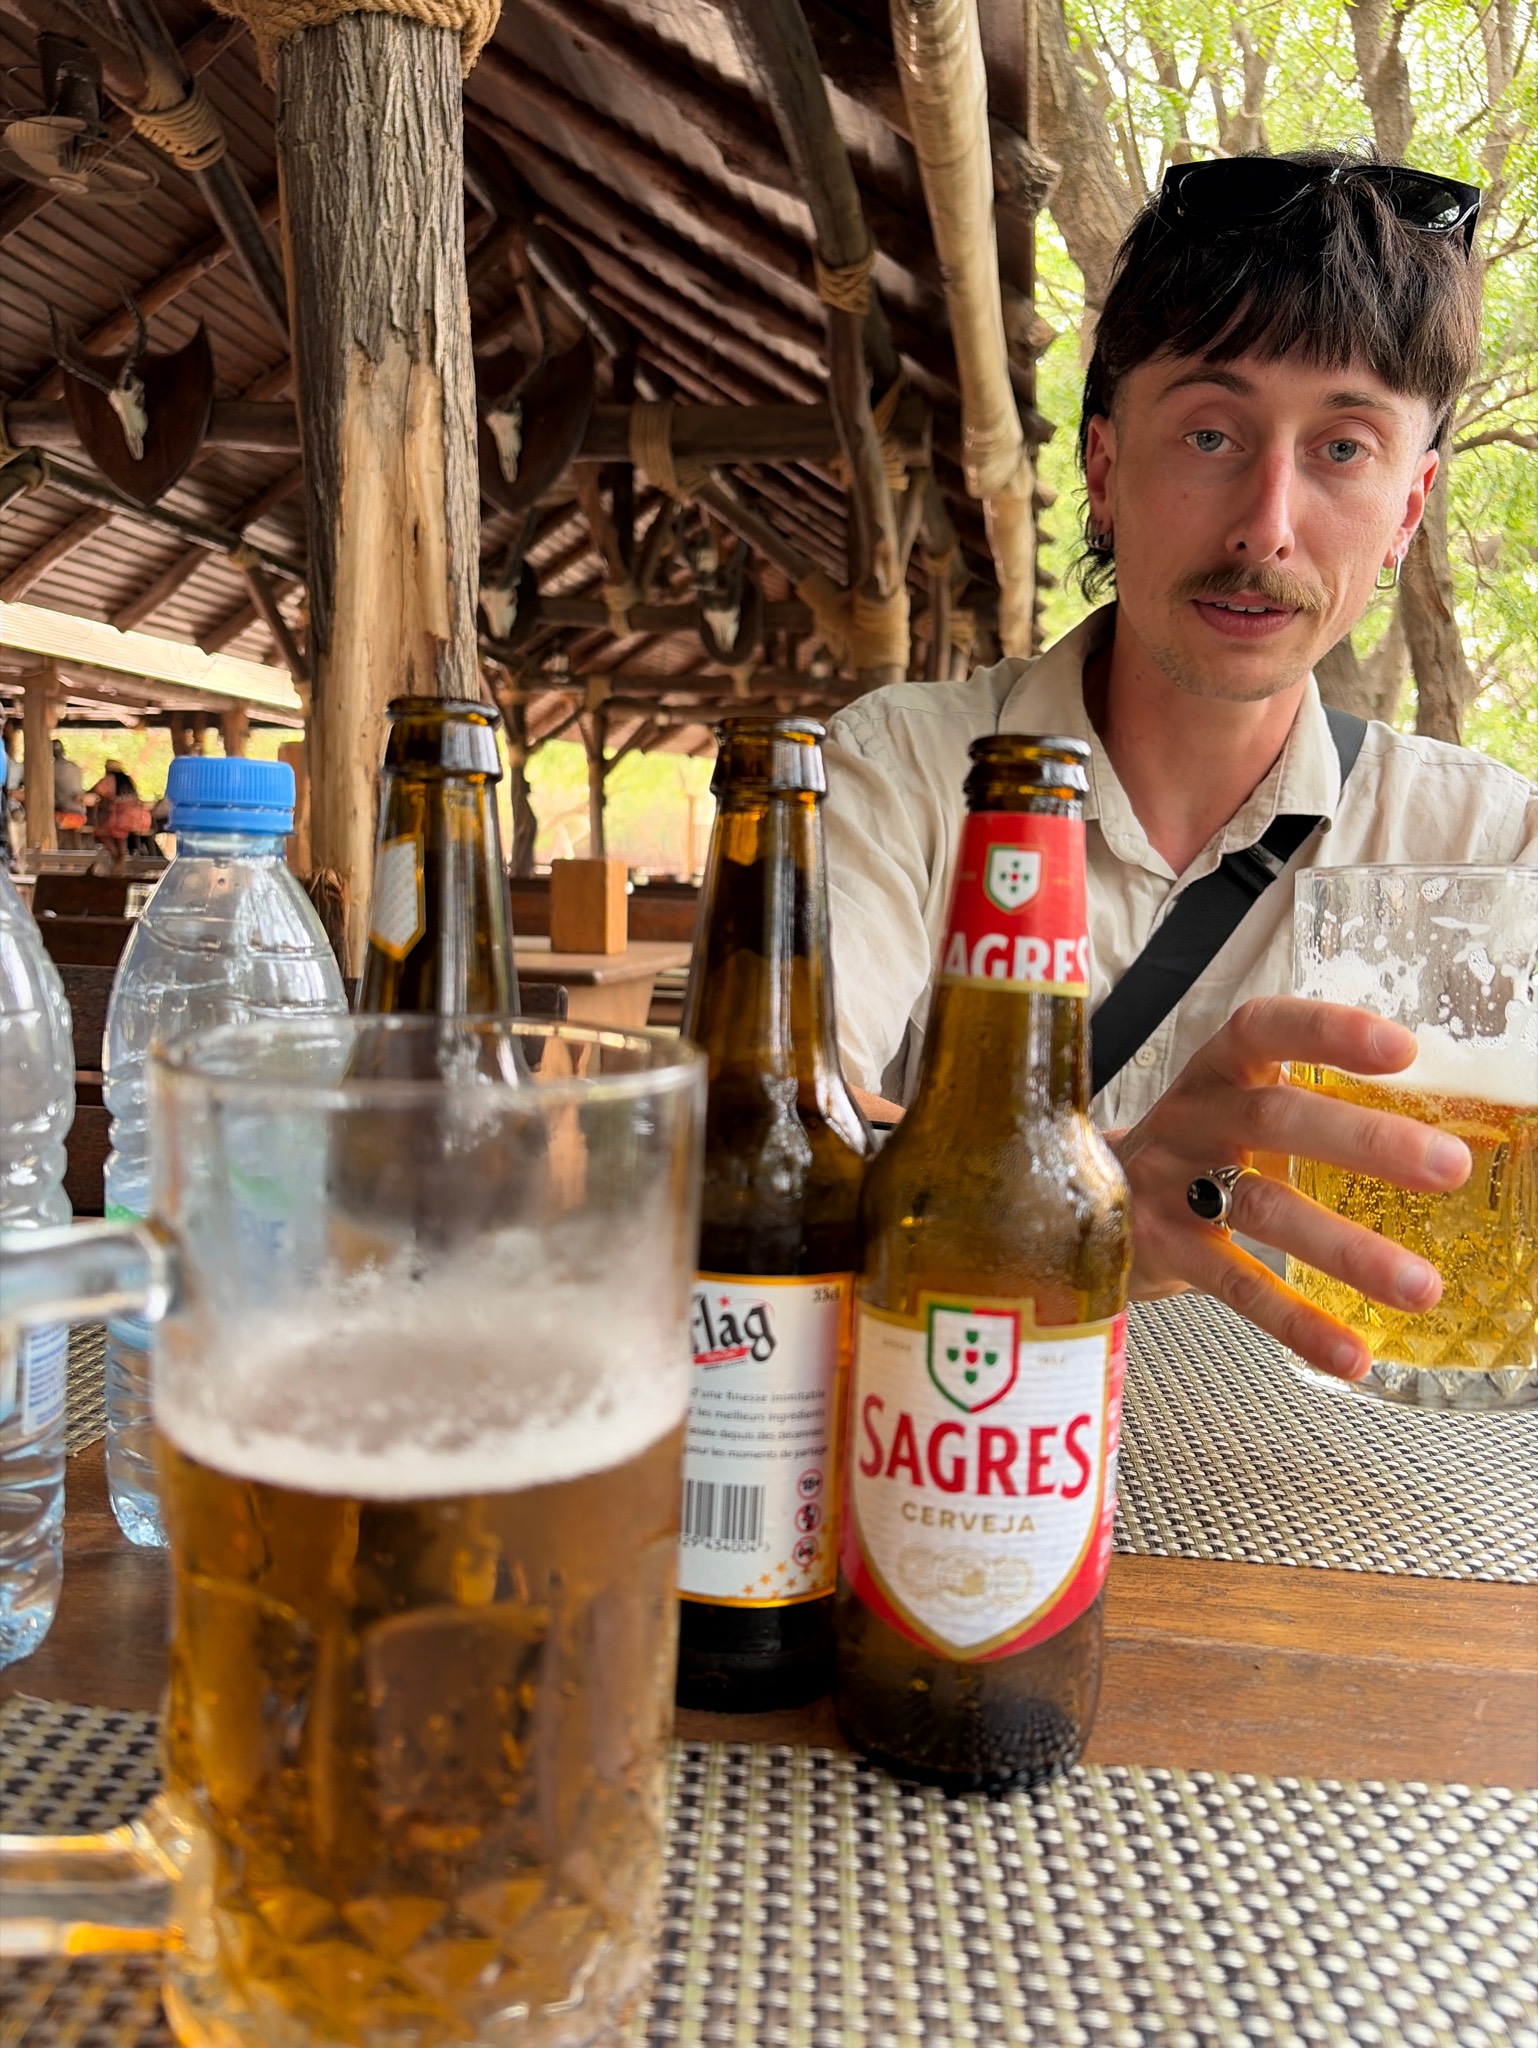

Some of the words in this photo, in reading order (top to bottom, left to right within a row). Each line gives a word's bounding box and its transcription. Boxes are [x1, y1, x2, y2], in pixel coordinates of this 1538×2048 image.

[943, 930, 1089, 983] AGRES
[859, 1393, 1092, 1499] SAGRES
[902, 1501, 1035, 1534] CERVEJA
